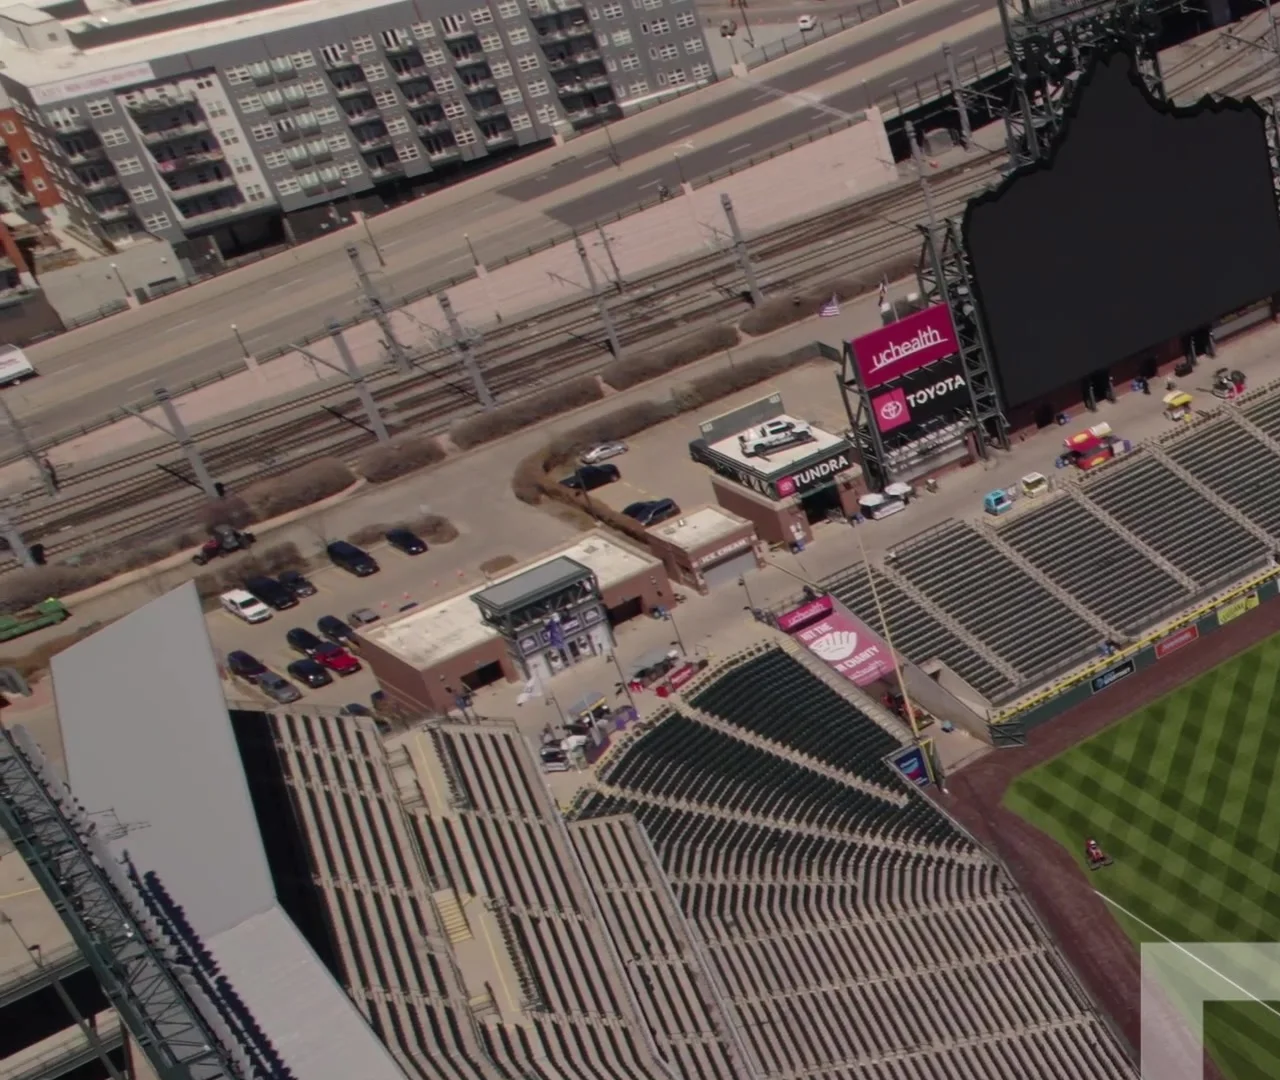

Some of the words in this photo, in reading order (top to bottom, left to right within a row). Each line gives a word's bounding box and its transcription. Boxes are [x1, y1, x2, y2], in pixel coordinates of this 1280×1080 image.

[870, 326, 944, 371] uchealth
[906, 374, 966, 408] TOYOTA
[792, 456, 849, 488] TUNDRA
